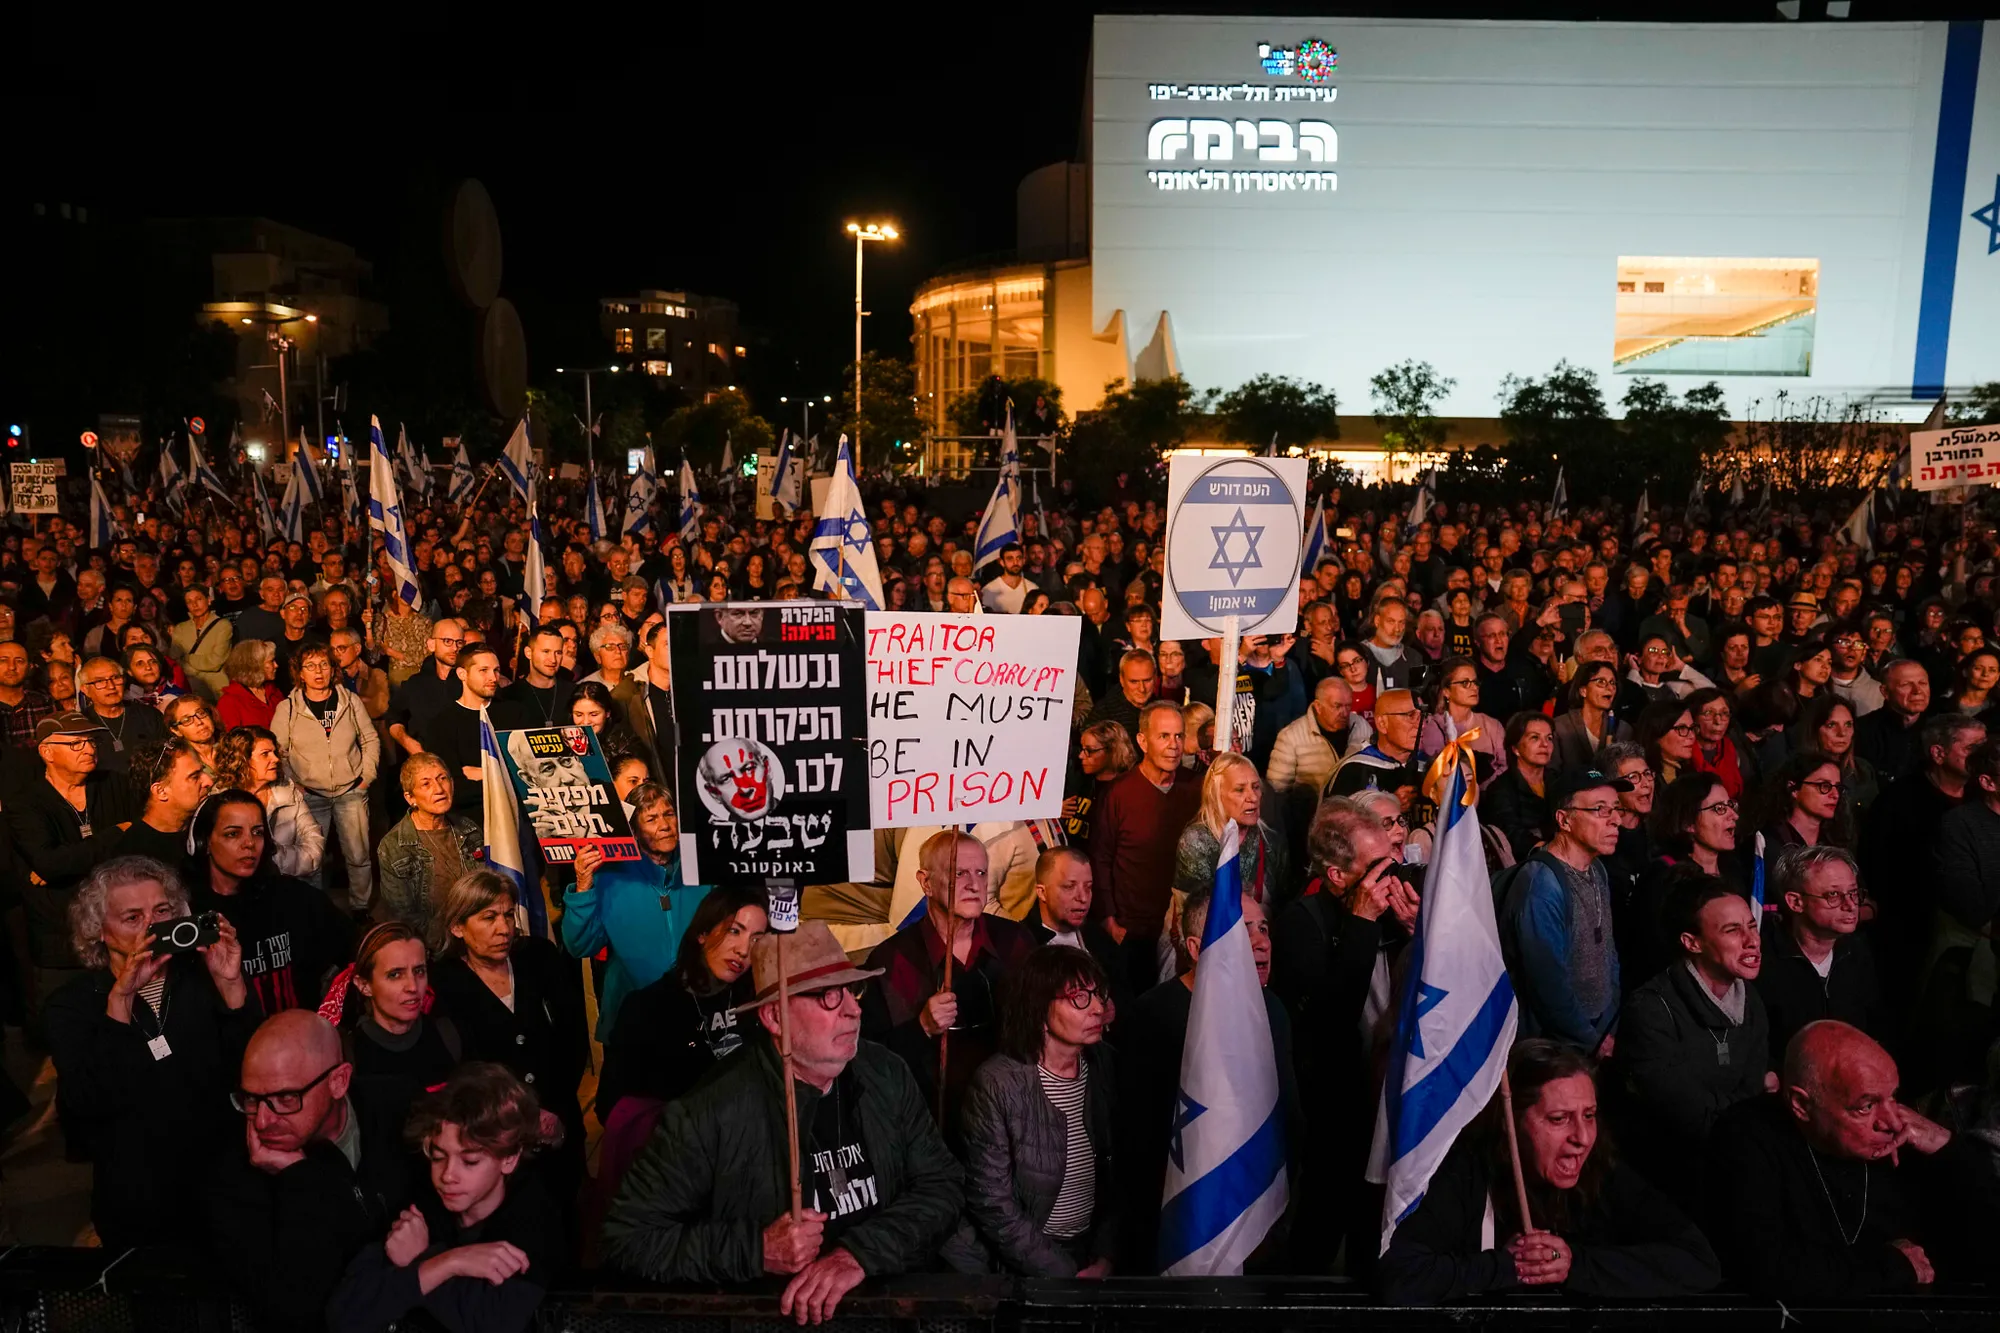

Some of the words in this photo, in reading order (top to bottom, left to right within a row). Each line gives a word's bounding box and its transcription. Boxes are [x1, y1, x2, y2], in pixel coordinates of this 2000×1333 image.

[1275, 86, 1338, 103] עיריית
[1148, 168, 1230, 191] הלאומי
[1233, 171, 1338, 193] התיאטרון
[1936, 428, 2000, 447] ממשלת
[1925, 448, 1984, 466] החורבן
[1920, 462, 2000, 481] הביתה
[1209, 483, 1241, 496] דורש
[1243, 483, 1271, 497] העם
[1209, 595, 1241, 612] אמון!
[1243, 595, 1256, 608] אי
[781, 607, 835, 626] הפקרת
[781, 623, 836, 641] הביתה!
[868, 623, 996, 656] TRAITOR
[703, 649, 841, 690] נכשלתם.
[953, 658, 1064, 692] CORRUPT
[870, 691, 919, 720] HE
[946, 692, 1063, 724] MUST
[702, 706, 842, 746] הפקרתם.
[528, 734, 562, 745] הדחה
[532, 743, 564, 754] עכשיו
[871, 738, 921, 778] BE
[953, 735, 994, 768] IN
[785, 753, 844, 793] לכו.
[527, 784, 610, 813] מפקיר
[887, 767, 1049, 820] PRISON
[544, 845, 575, 861] יותר
[601, 843, 639, 858] מגיע
[728, 860, 816, 877] באוקטובר
